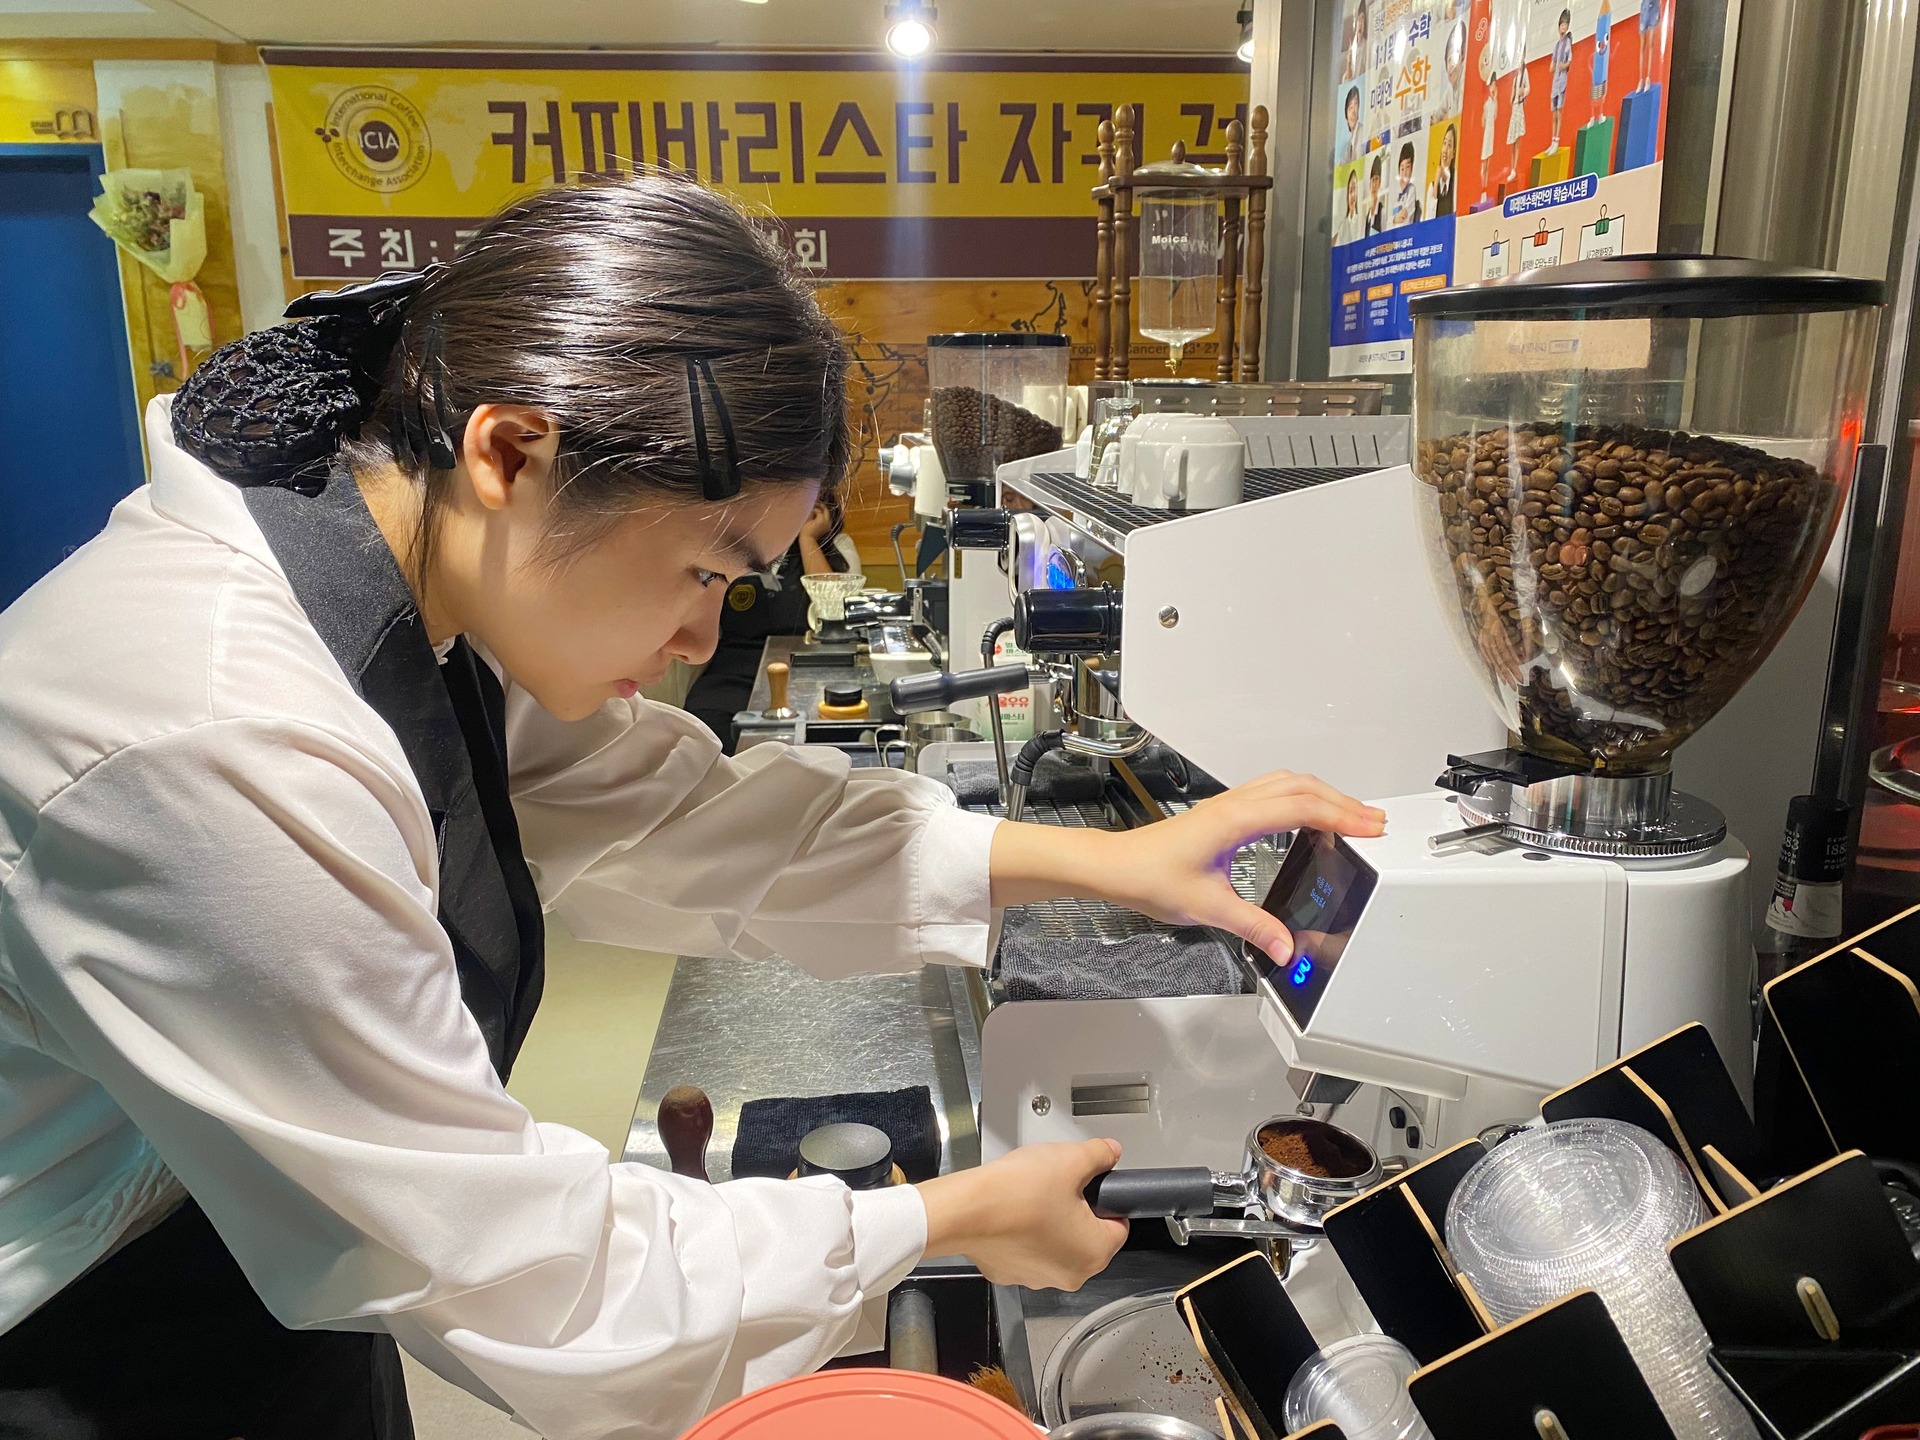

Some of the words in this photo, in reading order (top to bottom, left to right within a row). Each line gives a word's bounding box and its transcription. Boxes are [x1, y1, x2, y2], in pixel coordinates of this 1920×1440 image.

[1409, 11, 1431, 47] 수학
[1370, 75, 1393, 109] 미래엔
[1394, 55, 1431, 111] 수학
[333, 92, 387, 127] International
[391, 97, 420, 128] Coffee
[358, 131, 400, 149] ICIA
[487, 101, 968, 184] 커피바리스타
[334, 142, 383, 187] Interchange
[386, 145, 425, 186] Association
[1553, 178, 1589, 204] 학습시스템
[986, 696, 1029, 708] 울우유
